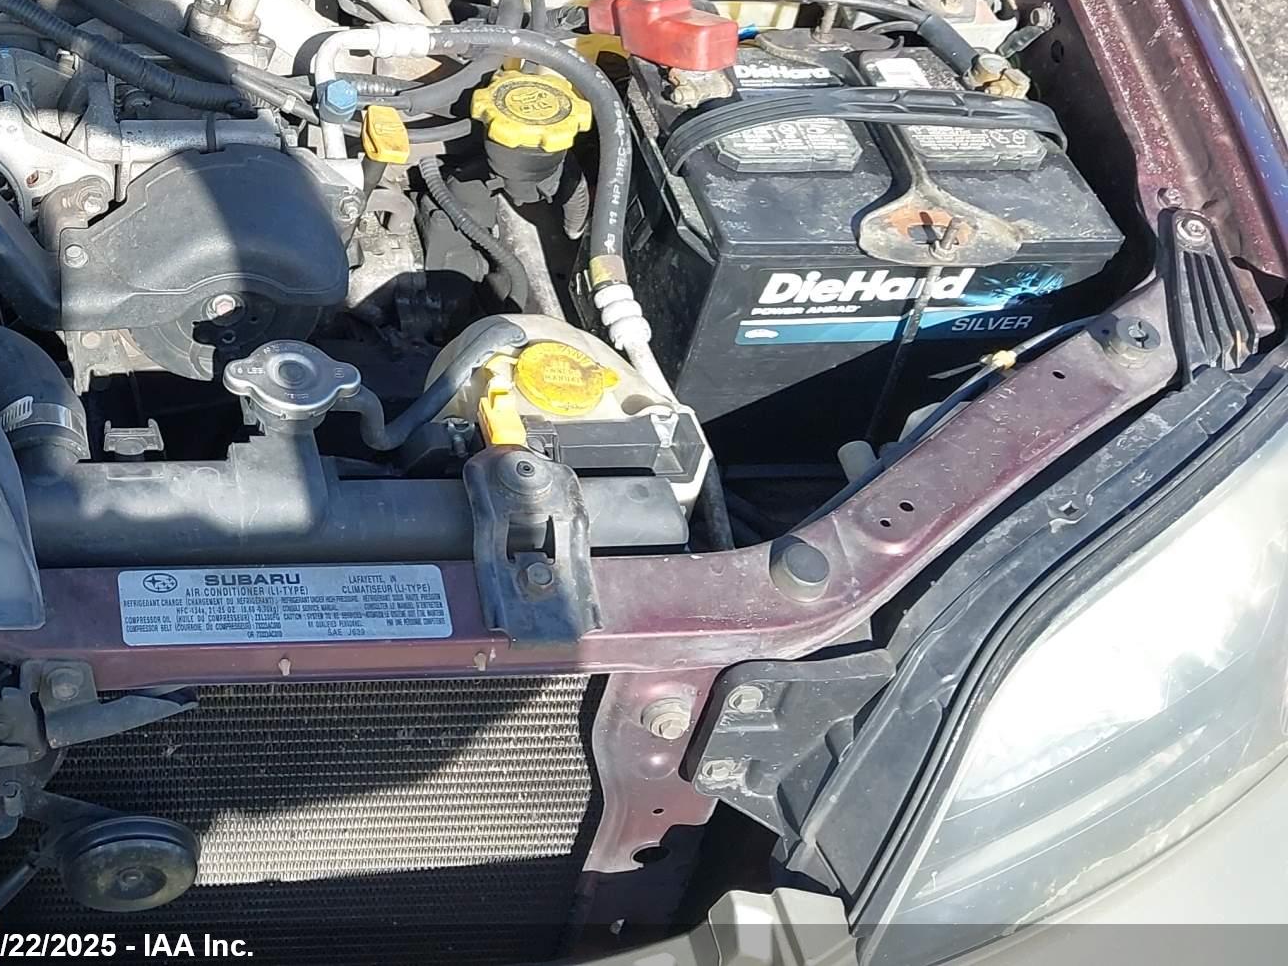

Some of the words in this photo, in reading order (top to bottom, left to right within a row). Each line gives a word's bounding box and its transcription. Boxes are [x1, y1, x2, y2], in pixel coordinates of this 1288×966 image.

[751, 307, 805, 316] POWER
[951, 315, 1033, 332] SILVER
[204, 573, 300, 586] SUBARU
[185, 588, 200, 597] AIR
[203, 587, 264, 597] CONDITIONER
[268, 585, 309, 596] (LI-TYPE)
[341, 584, 393, 594] CLIMATISEUR
[394, 583, 431, 593] (LI-TYPE)
